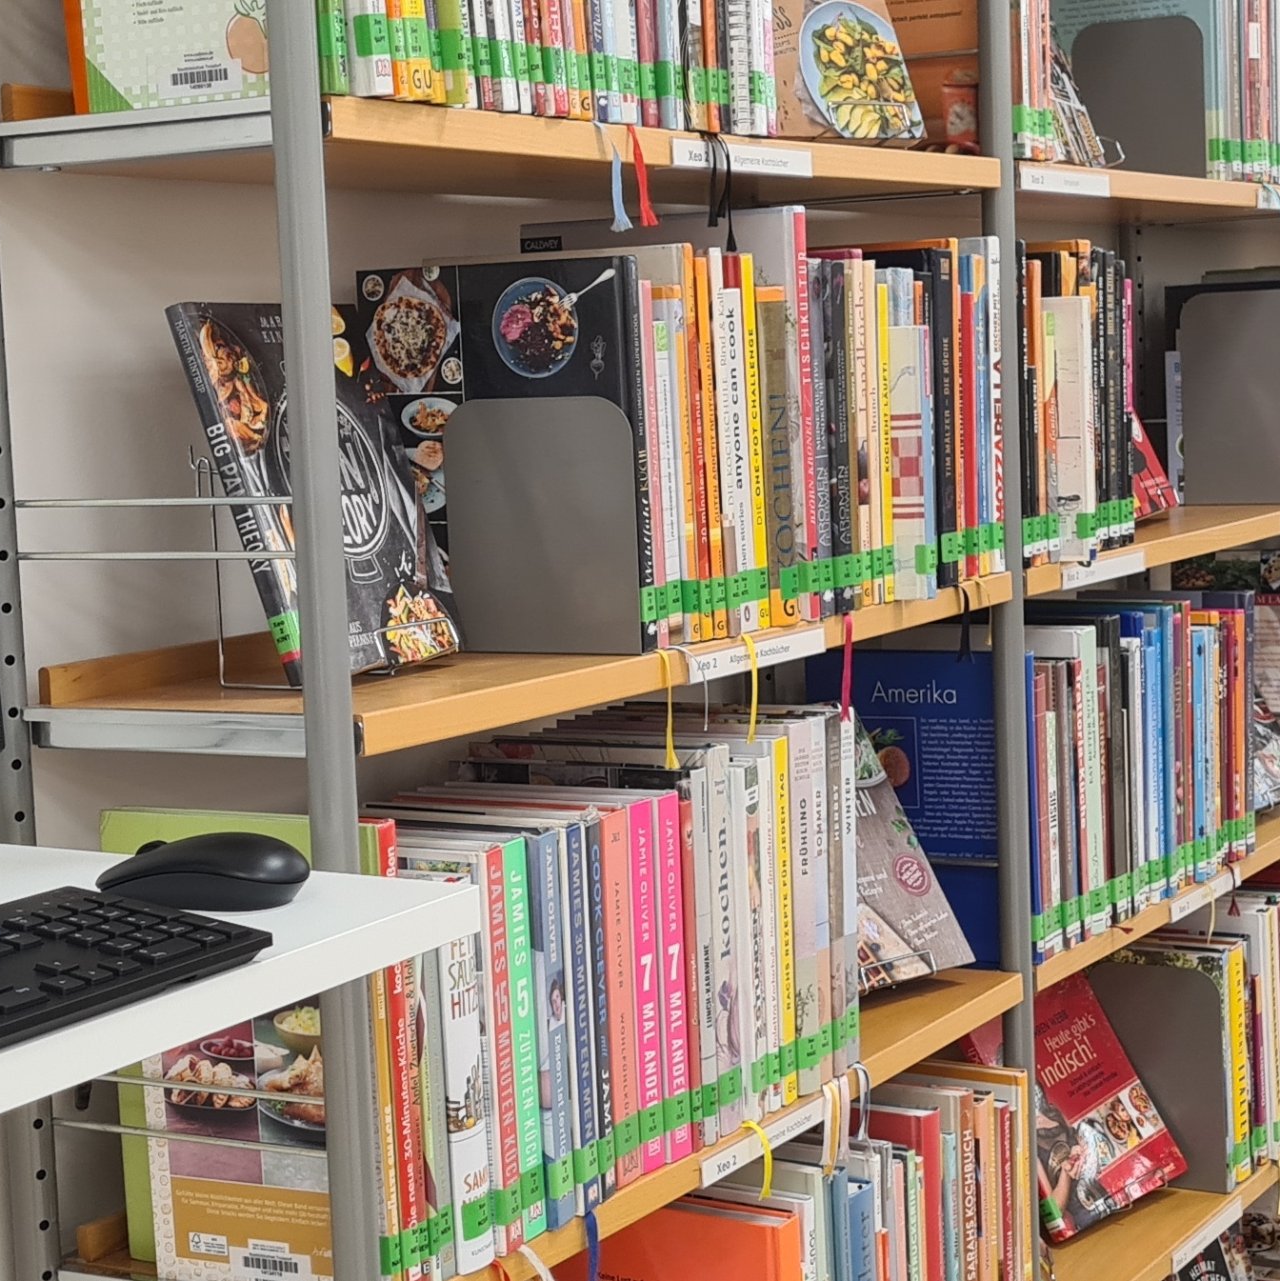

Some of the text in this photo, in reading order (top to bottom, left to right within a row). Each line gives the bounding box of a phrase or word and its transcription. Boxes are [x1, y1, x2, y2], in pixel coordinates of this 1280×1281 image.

[725, 307, 737, 360] cook
[797, 251, 813, 385] TISCHKULTUR
[174, 319, 207, 395] MARTIN KINTRUP
[729, 368, 739, 405] can
[748, 328, 758, 420] CHALLENGE
[206, 422, 231, 458] BIG
[732, 413, 744, 489] anyone
[870, 680, 957, 705] Amerika
[799, 797, 809, 876] FRÜHLING
[815, 790, 823, 857] SOMMER
[832, 783, 840, 841] HERBST
[1049, 790, 1057, 829] SUSHI
[545, 845, 555, 899] JAMIE
[717, 817, 732, 960] kochen.
[489, 865, 507, 973] JAMIES
[547, 902, 558, 963] OLIVER
[614, 881, 624, 989] JAMIE OLIVER
[571, 837, 594, 1138] JAMIES 30-MINUTEN-MEN
[591, 844, 612, 1136] COOK CLEVER mit JAMI
[637, 828, 659, 1108] JAMIE OLIVER 7 MAL ANDE
[665, 819, 685, 1095] JAMIE OLIVER 7 MAL ANDE
[509, 870, 539, 1168] JAMIES 5 ZUTATEN-KÜCH
[1043, 1012, 1097, 1053] Heute gibt's
[395, 1018, 413, 1158] 30-Minuten-Küche
[553, 1033, 564, 1083] Essen
[1036, 1035, 1097, 1088] indisch!
[497, 1029, 521, 1180] MINUTEN-KÜC
[556, 1088, 565, 1106] ist
[407, 1163, 417, 1203] neue
[463, 1167, 487, 1194] SAM
[717, 1160, 731, 1176] Xeo
[732, 1155, 738, 1167] 2
[962, 1129, 977, 1281] SARAHS KOCHBUCH
